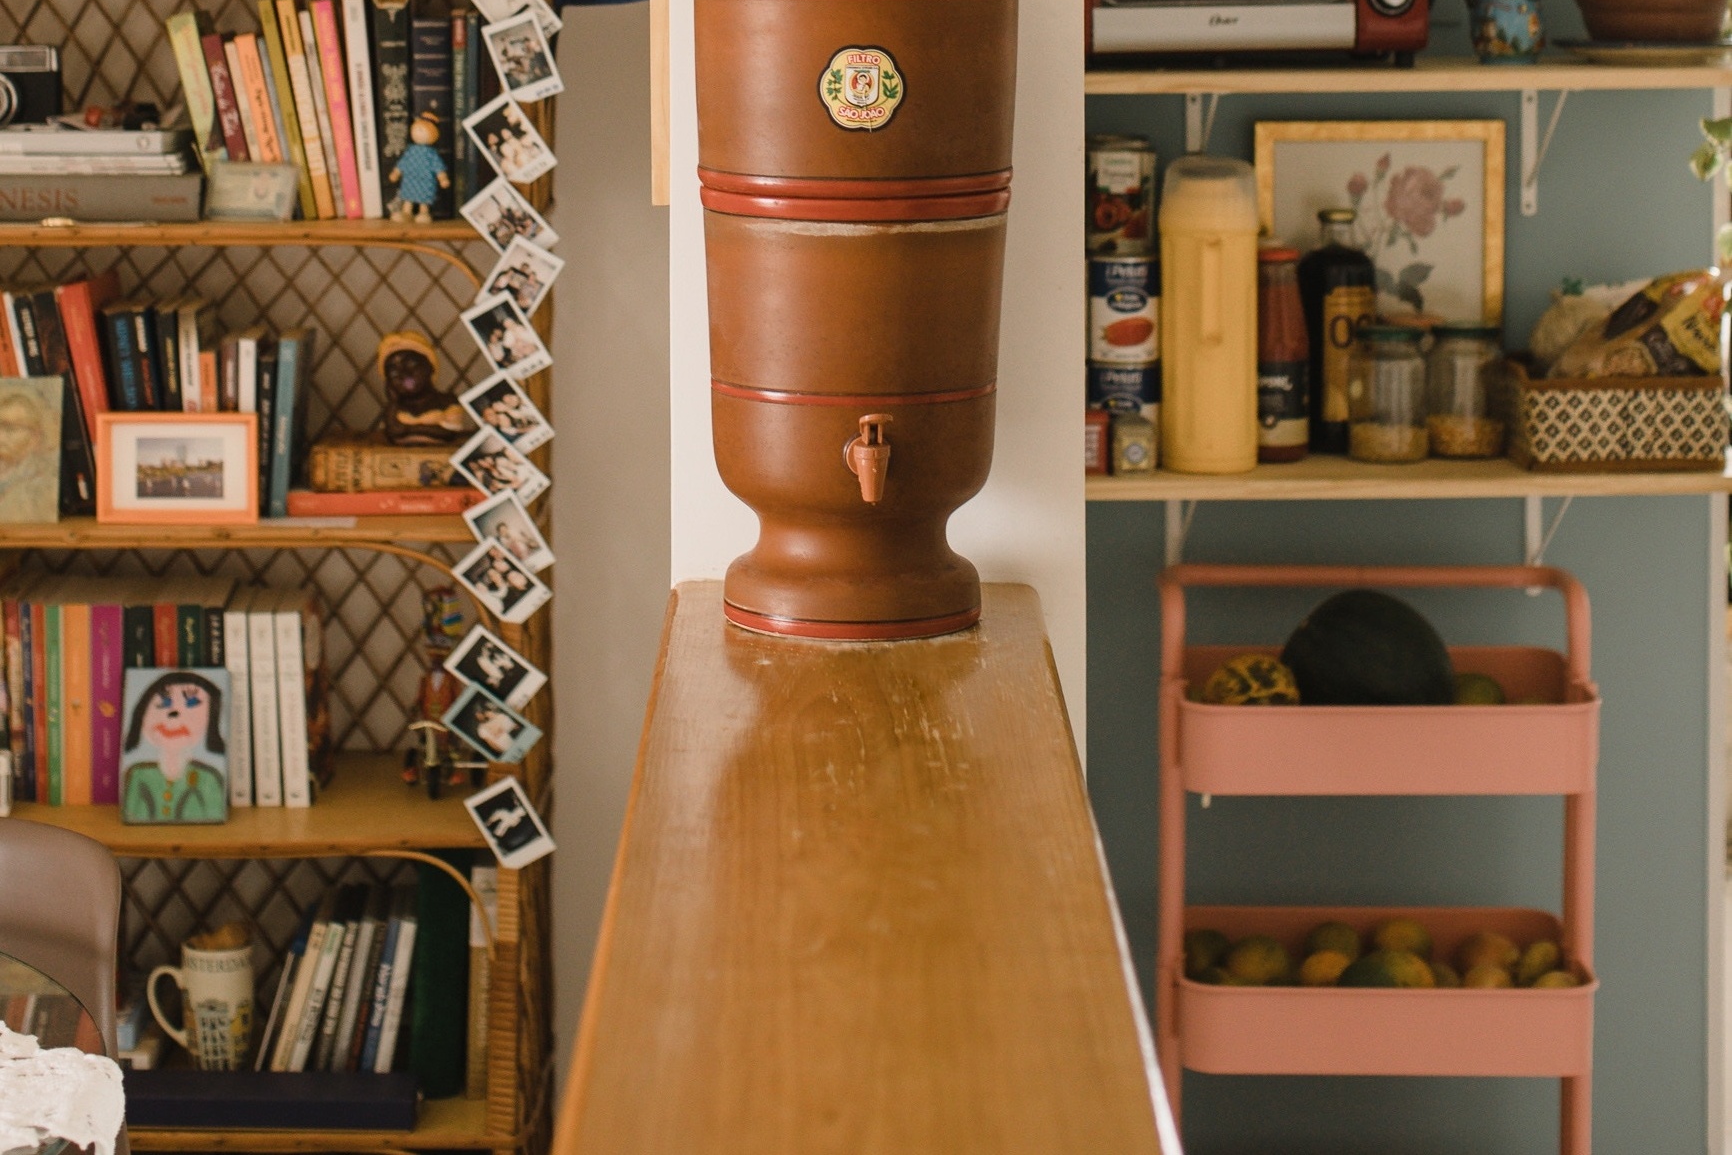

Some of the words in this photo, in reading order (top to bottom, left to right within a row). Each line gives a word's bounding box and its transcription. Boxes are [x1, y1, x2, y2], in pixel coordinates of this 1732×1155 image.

[848, 54, 880, 65] FILTRO
[838, 107, 858, 119] SÃO
[859, 107, 884, 119] JOÃO
